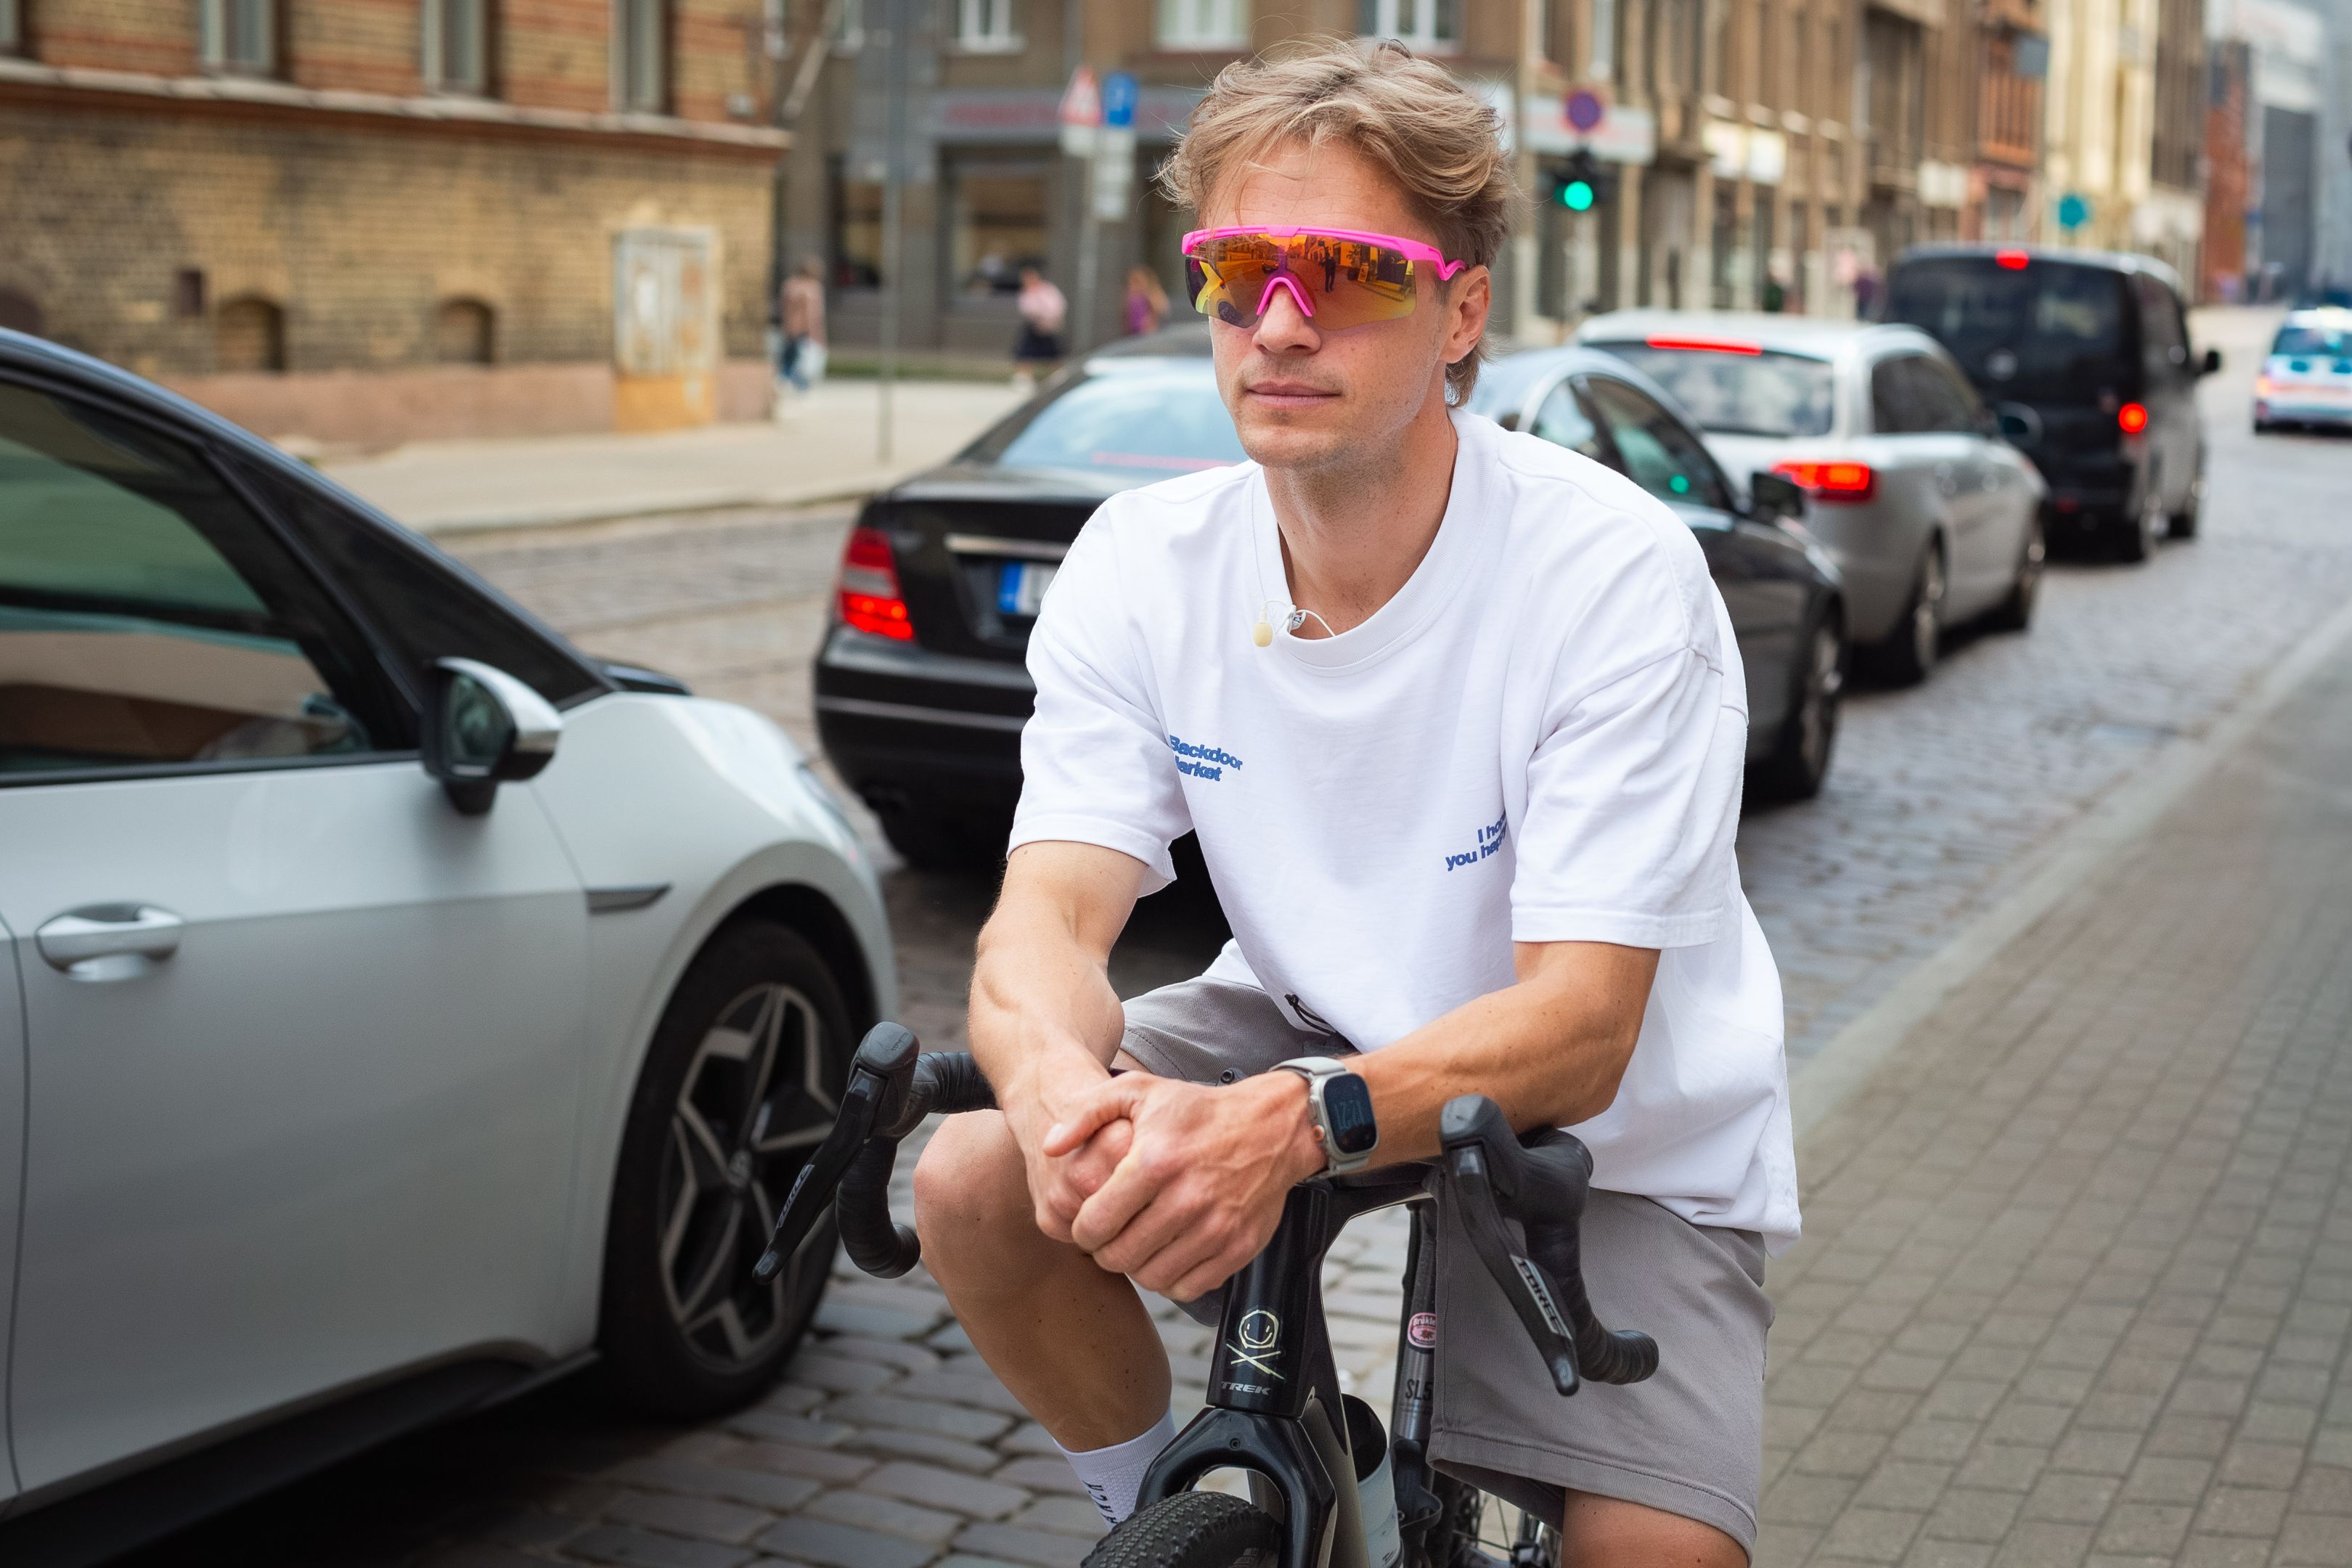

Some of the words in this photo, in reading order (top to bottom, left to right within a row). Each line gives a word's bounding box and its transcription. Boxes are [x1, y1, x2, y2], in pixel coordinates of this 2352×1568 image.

[1169, 735, 1243, 771] Backdoor
[1477, 828, 1484, 844] I
[1445, 851, 1477, 872] you
[1221, 1381, 1271, 1395] TREK
